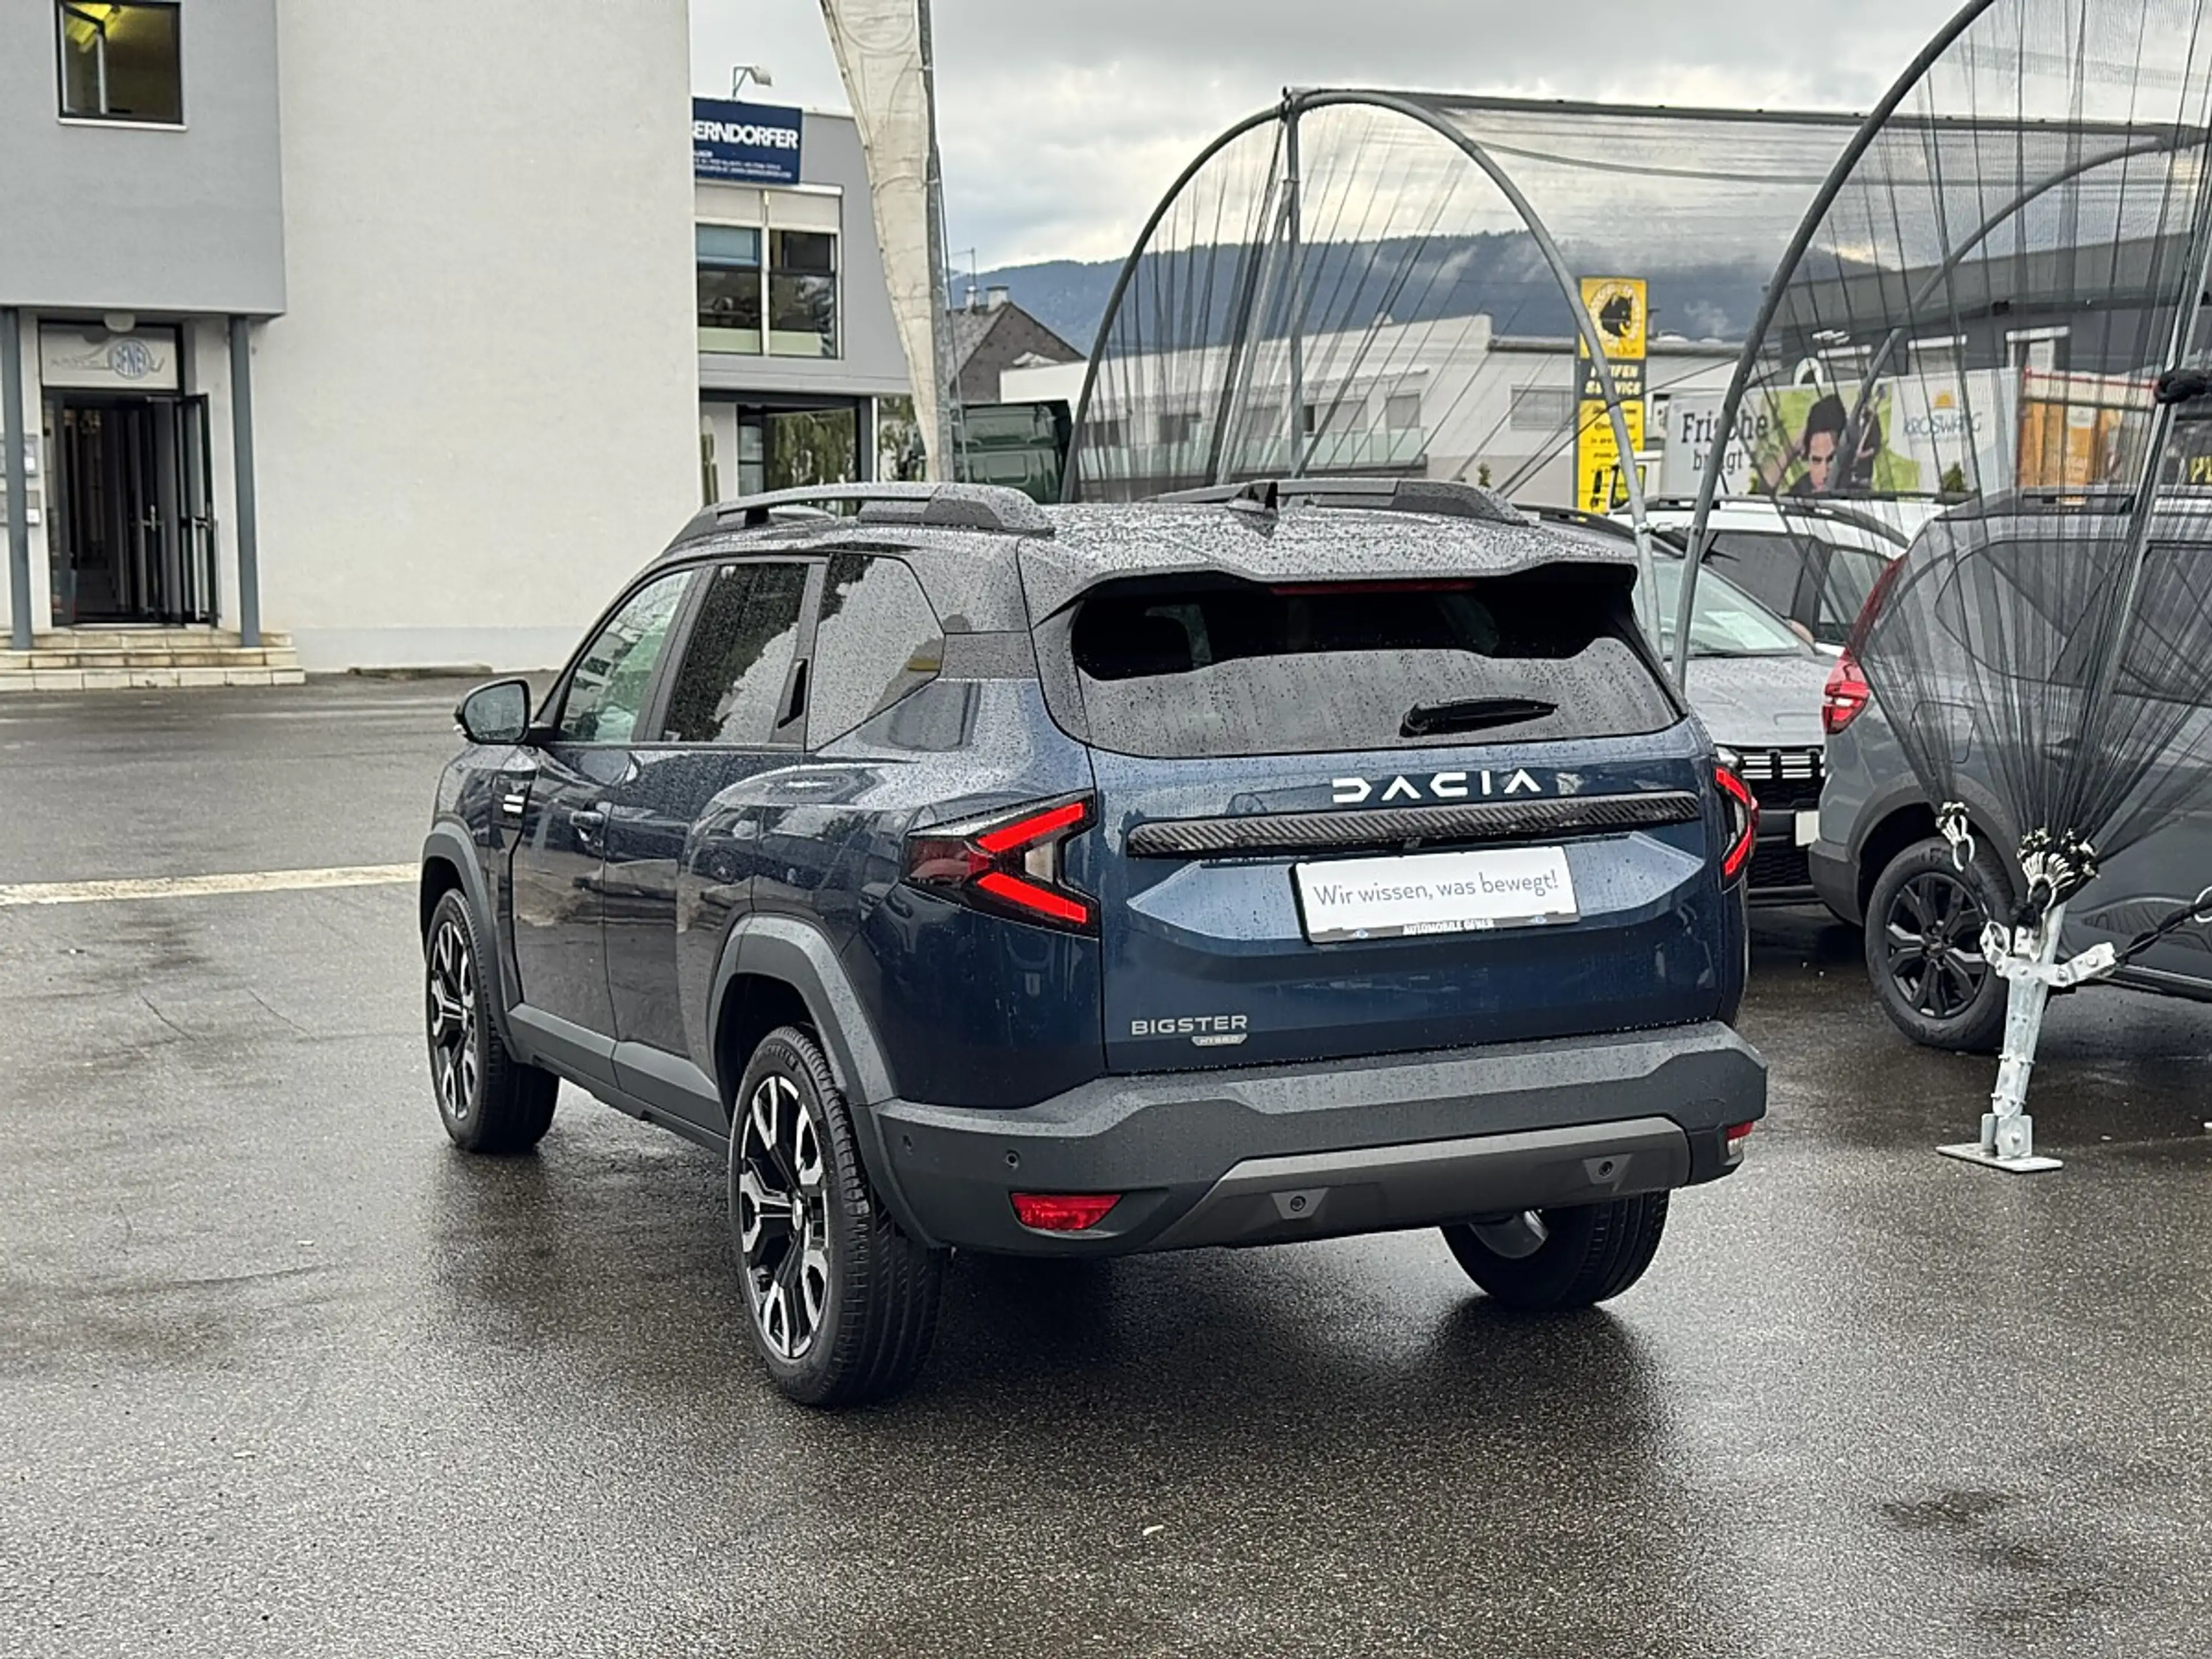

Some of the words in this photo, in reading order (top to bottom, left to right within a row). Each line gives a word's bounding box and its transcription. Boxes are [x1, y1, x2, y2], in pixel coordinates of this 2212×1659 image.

[692, 120, 799, 150] ERNDORFER
[1681, 408, 1768, 444] Frihe
[1332, 768, 1542, 804] DACIA
[1313, 884, 1355, 907] Wir
[1358, 881, 1434, 903] wissen,
[1435, 881, 1476, 897] was
[1479, 869, 1559, 896] bewegt!
[1403, 921, 1463, 935] AUTOMOBILE
[1131, 1015, 1248, 1035] BIGSTER
